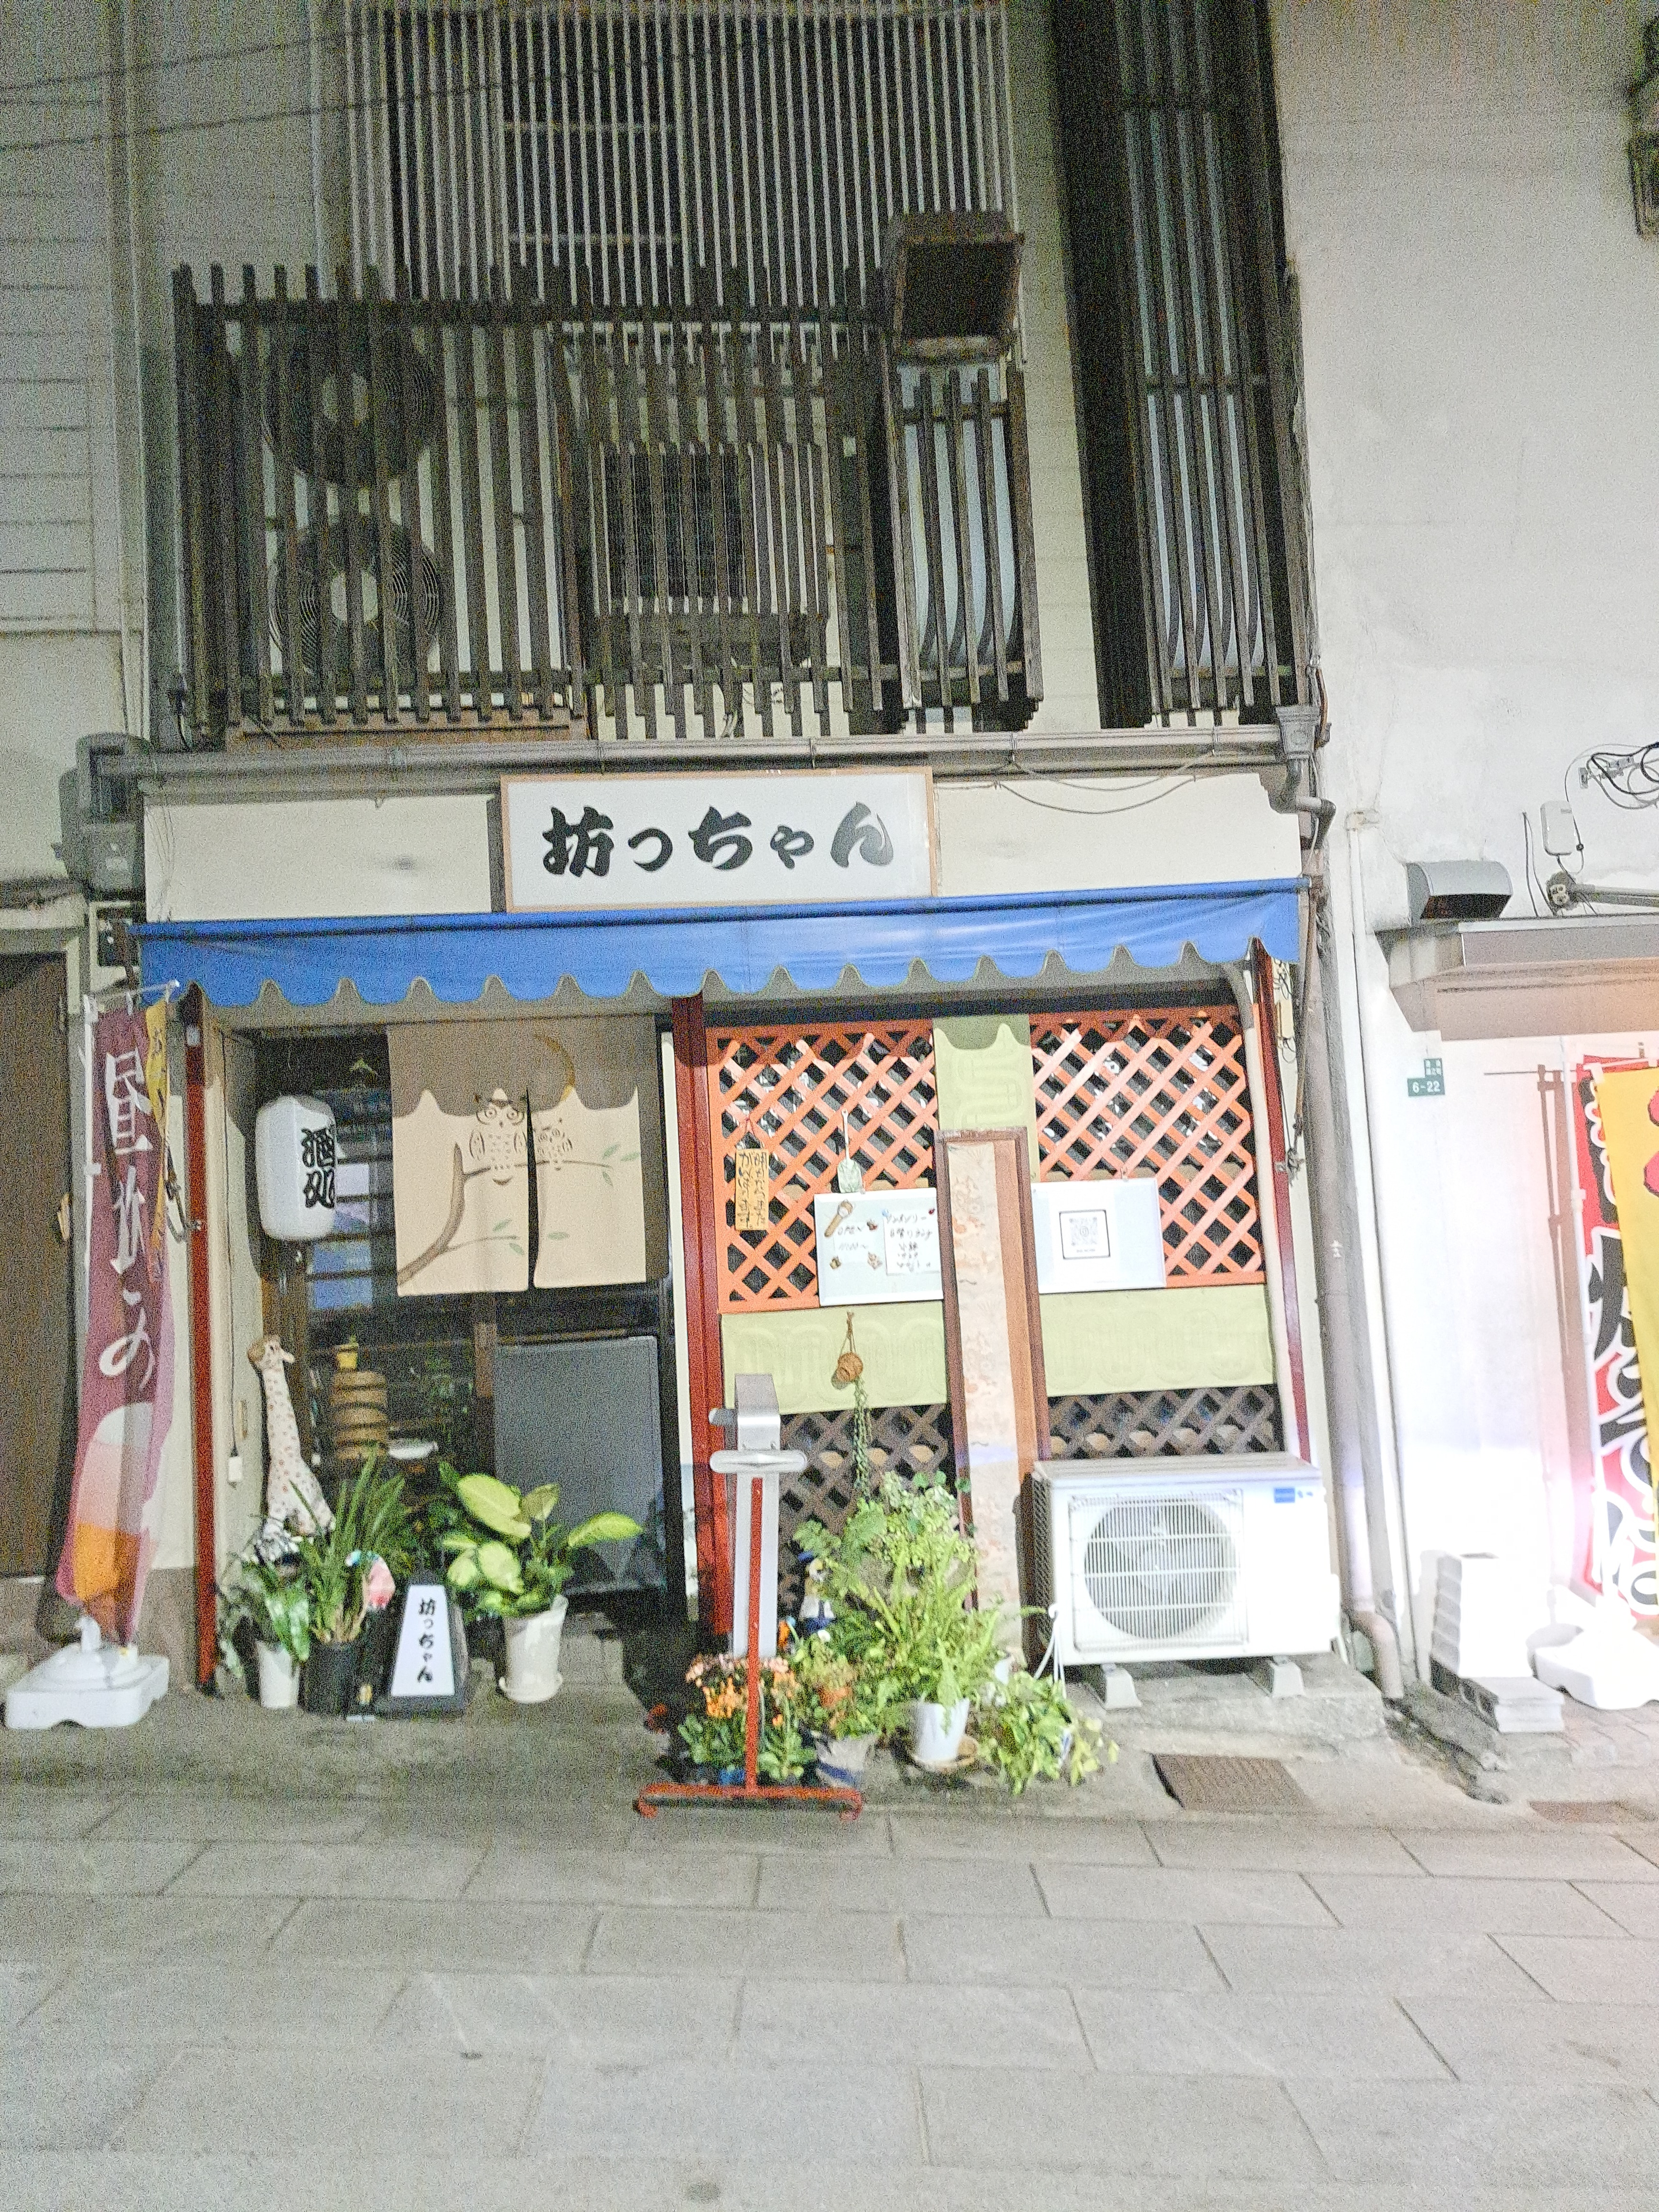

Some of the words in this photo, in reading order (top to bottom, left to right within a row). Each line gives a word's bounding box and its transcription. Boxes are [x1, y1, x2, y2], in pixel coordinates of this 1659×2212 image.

[542, 801, 894, 877] 坊っちゃん
[1412, 1080, 1441, 1094] 6-22
[417, 1596, 436, 1683] 坊っちゃん
